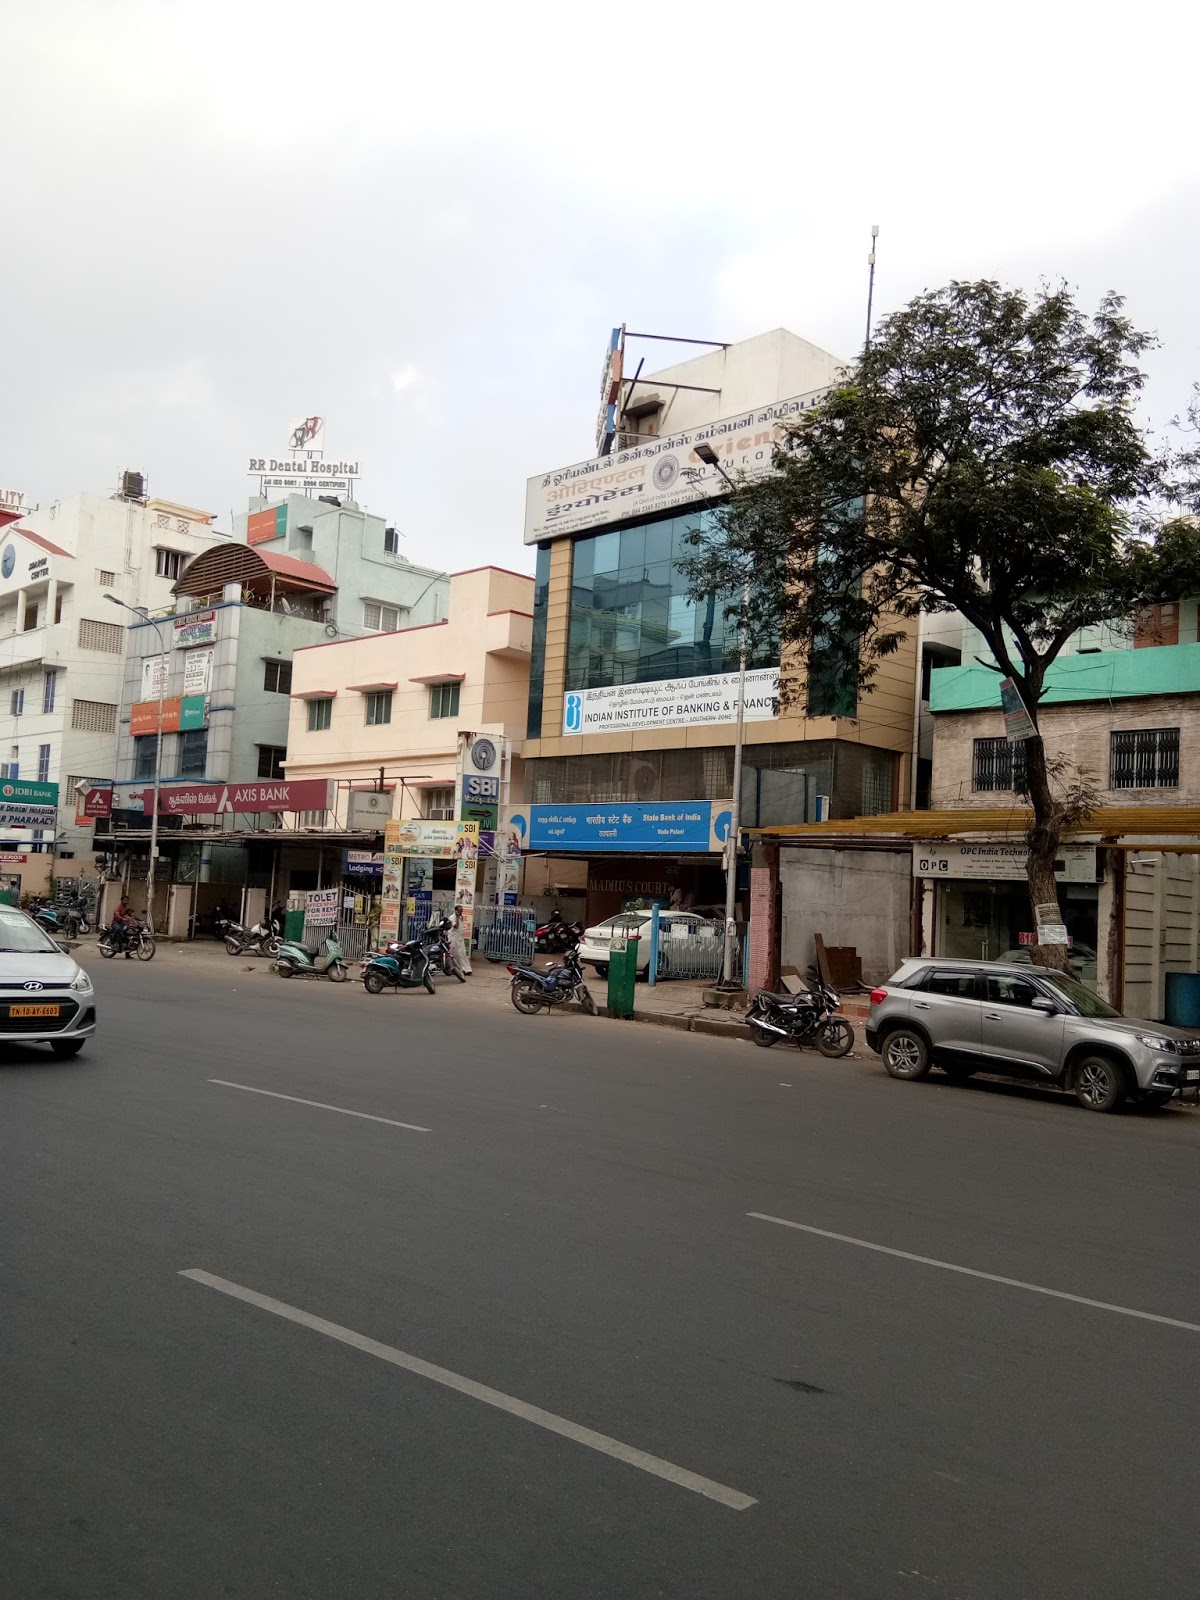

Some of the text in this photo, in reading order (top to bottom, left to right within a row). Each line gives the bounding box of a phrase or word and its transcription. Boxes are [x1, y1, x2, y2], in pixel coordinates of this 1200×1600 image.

[695, 414, 754, 442] கம்பெனி
[249, 459, 359, 476] RR Dental Hospital
[318, 480, 347, 488] CERTIFIED
[642, 504, 654, 512] 2345
[681, 494, 694, 503] 2345
[722, 677, 729, 686] &
[585, 711, 613, 722] INDIAN
[615, 706, 659, 720] INSTITUTE
[661, 705, 674, 716] OF
[676, 701, 720, 714] BANKING
[723, 700, 730, 711] &
[599, 722, 631, 730] PROFESSIONAL
[632, 719, 666, 727] DEVELOPMENT
[666, 717, 685, 725] CENTRE
[468, 777, 497, 796] SBI
[15, 787, 52, 798] IDBI BANK
[235, 786, 290, 801] AXIS BANK
[6, 805, 28, 813] Dental
[29, 807, 57, 816] Hospital
[8, 815, 55, 825] PHARMACY
[586, 813, 632, 824] भारतीय स्टेट बैंक
[660, 813, 676, 821] Bank
[676, 813, 684, 821] of
[685, 813, 701, 821] India
[464, 824, 476, 833] SBI
[960, 847, 977, 855] OPC
[978, 847, 999, 855] India
[391, 857, 401, 865] SBI
[464, 860, 476, 869] SBI
[349, 864, 373, 874] Lodging
[635, 881, 669, 894] COURT
[12, 1007, 58, 1016] TN-10-AY-6603
